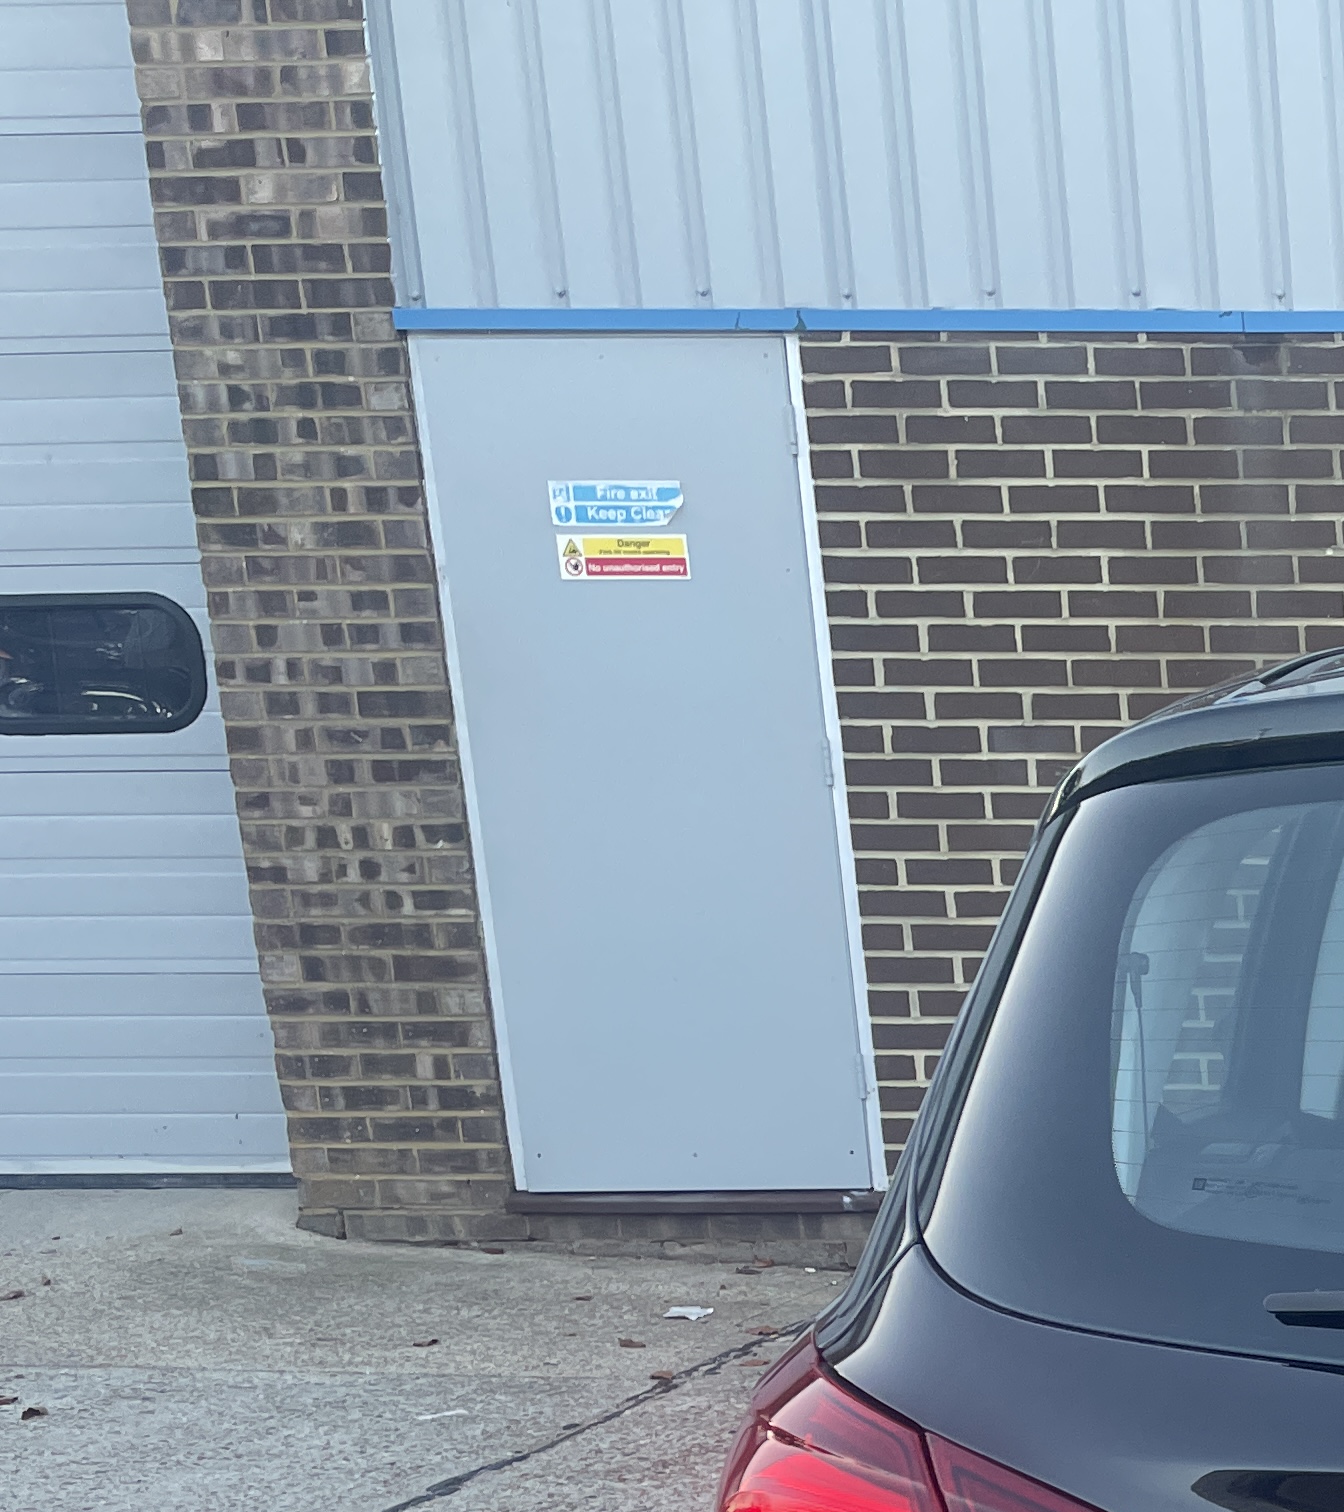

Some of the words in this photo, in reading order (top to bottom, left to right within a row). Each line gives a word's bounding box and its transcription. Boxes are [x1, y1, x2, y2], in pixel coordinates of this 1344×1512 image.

[596, 485, 625, 500] Fire
[630, 487, 658, 500] exit
[586, 506, 626, 523] Keep
[631, 506, 671, 521] Clear
[617, 539, 650, 549] Danger
[588, 563, 601, 572] No
[662, 564, 685, 574] entry
